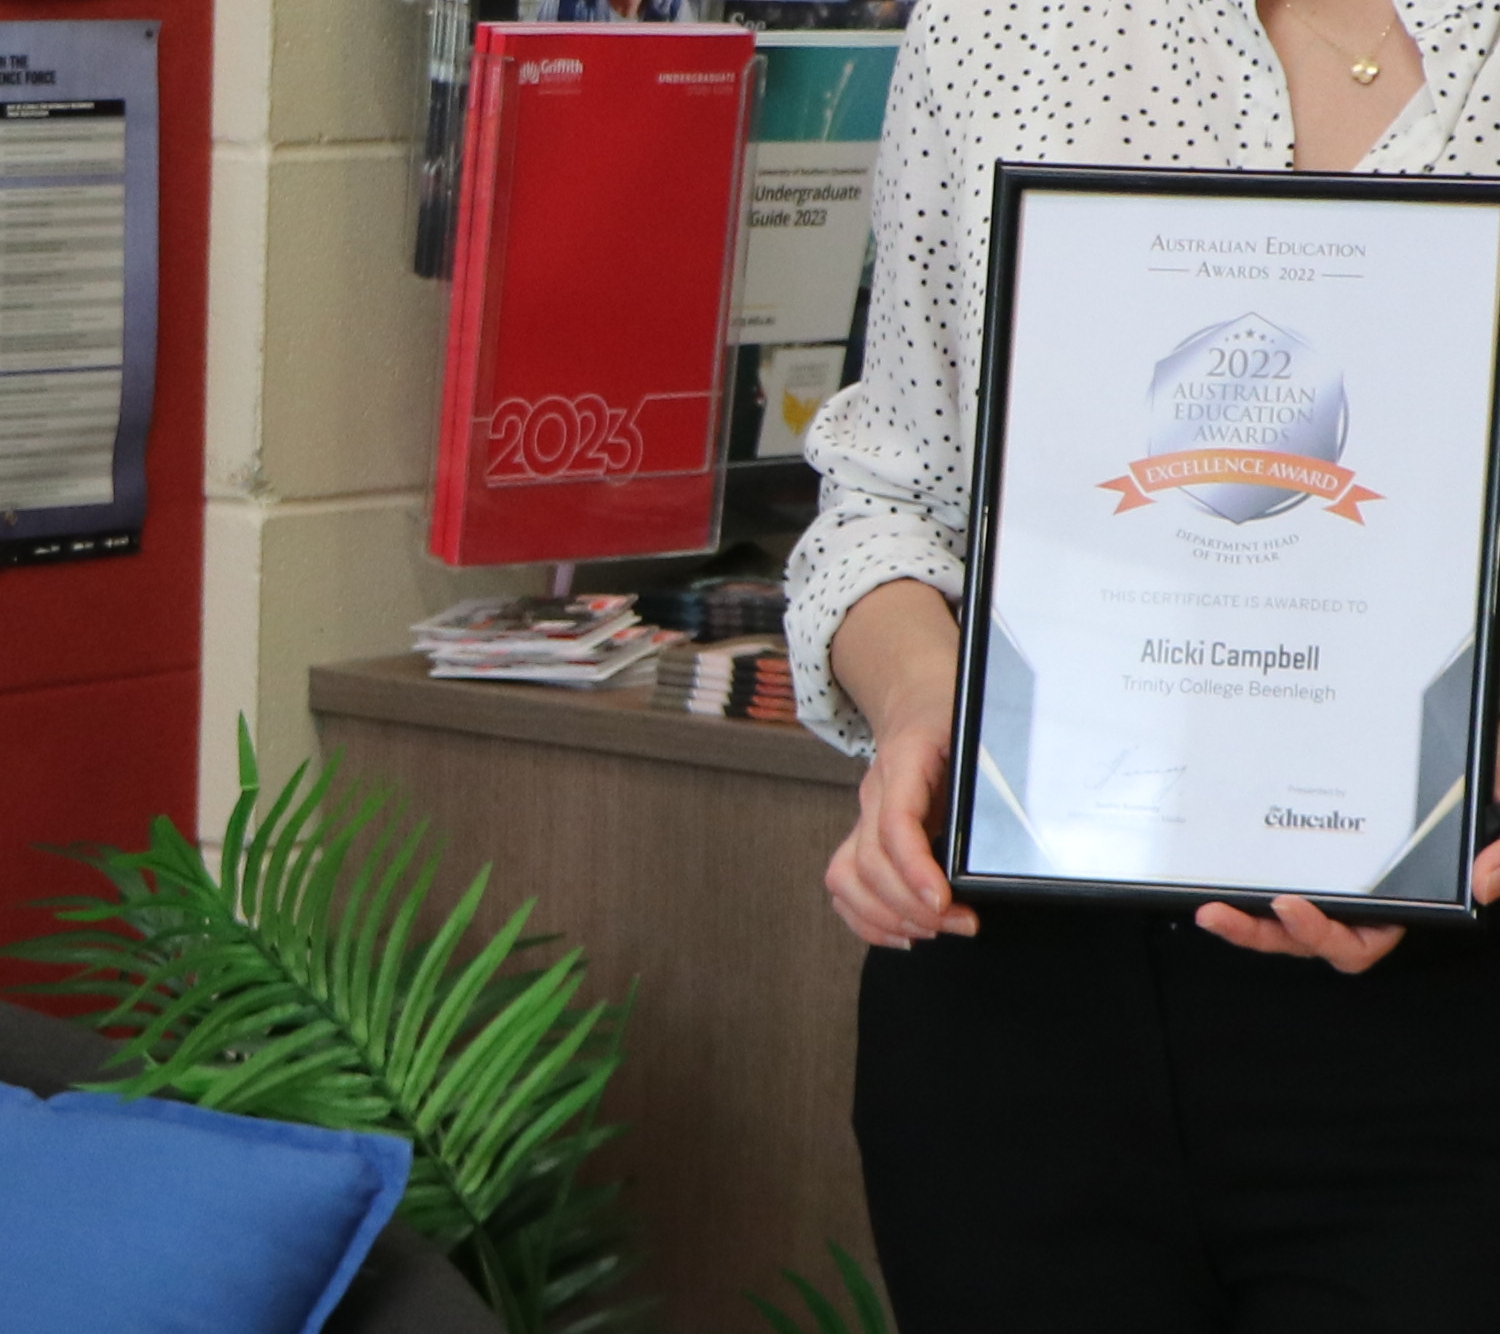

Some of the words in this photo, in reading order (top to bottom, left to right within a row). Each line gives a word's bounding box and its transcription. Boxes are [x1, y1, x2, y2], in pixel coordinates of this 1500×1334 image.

[541, 58, 583, 74] Griffith
[754, 182, 861, 205] Undergraduate
[750, 210, 790, 227] Guide
[794, 210, 827, 226] 2023
[1279, 268, 1315, 281] 2022
[1206, 348, 1291, 380] 2022
[1173, 382, 1316, 403] AUSTRALIAN
[1174, 403, 1314, 425] EDUCATION
[488, 394, 643, 485] 2023
[1192, 425, 1290, 445] AWARDS
[1146, 457, 1264, 483] EXCELLENCE
[1269, 461, 1338, 491] AWARD
[1141, 639, 1204, 665] Alicki
[1211, 642, 1320, 675] Campbell
[1122, 675, 1174, 695] Trinity
[1180, 678, 1244, 697] College
[1250, 681, 1336, 703] Beenleigh
